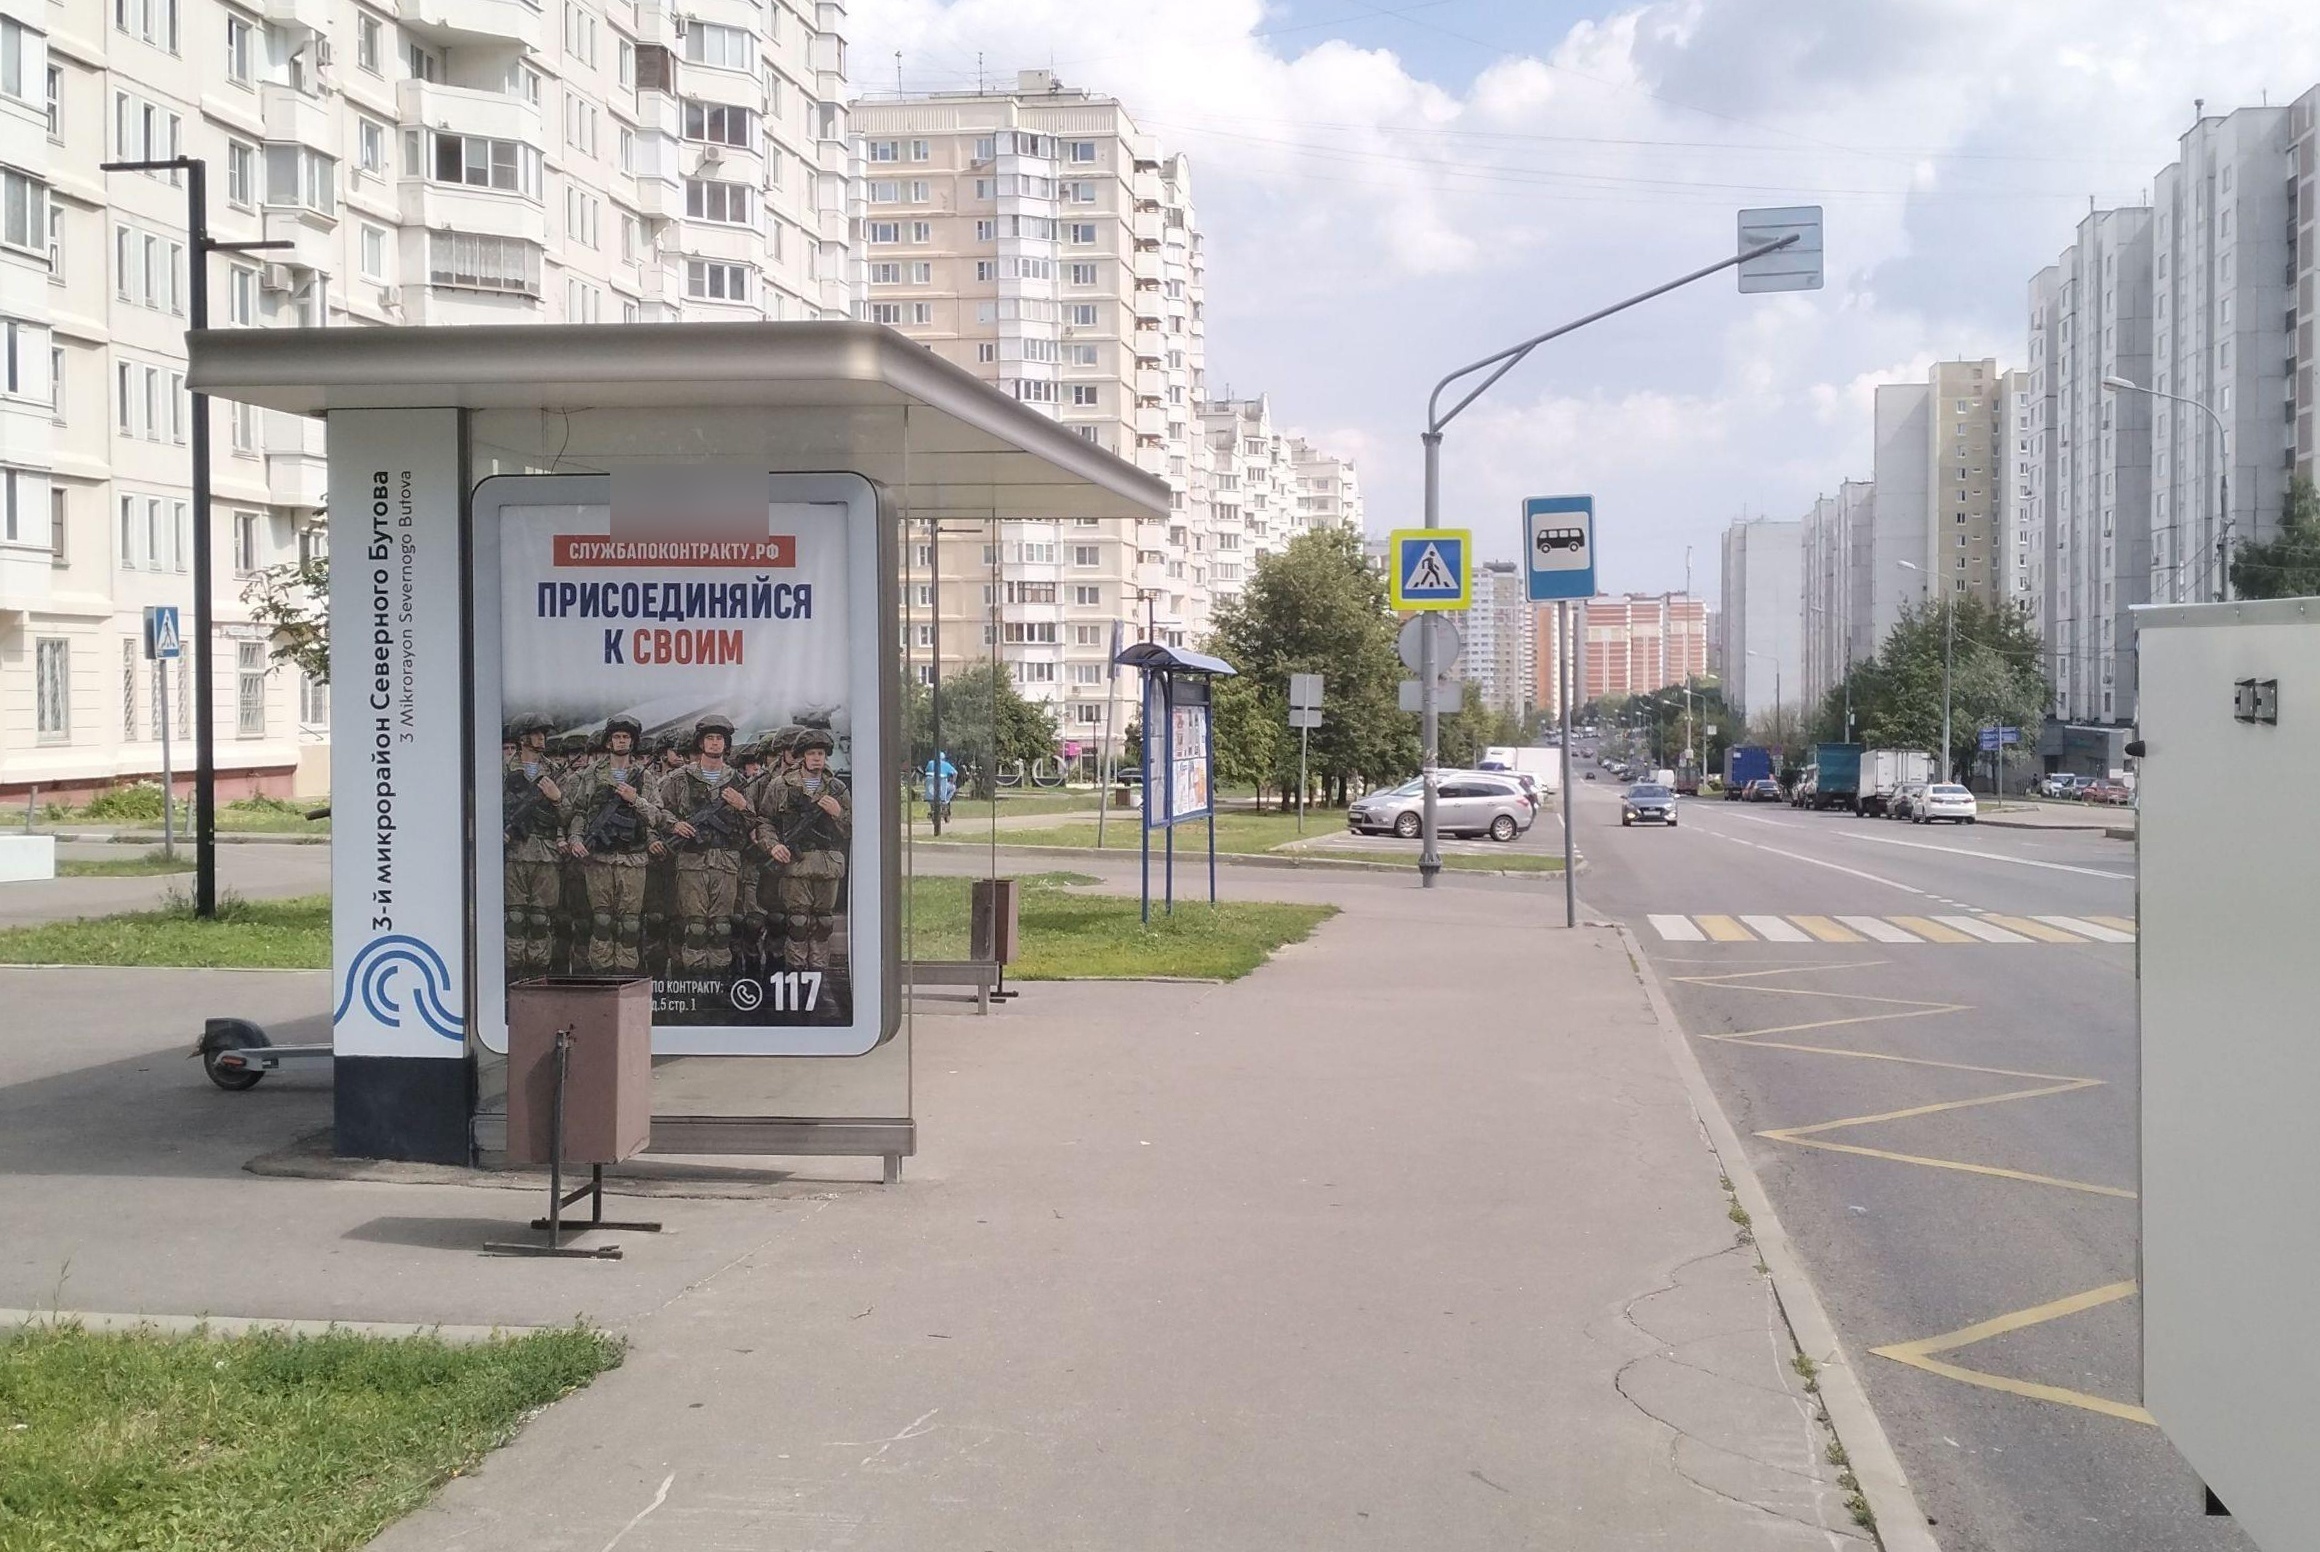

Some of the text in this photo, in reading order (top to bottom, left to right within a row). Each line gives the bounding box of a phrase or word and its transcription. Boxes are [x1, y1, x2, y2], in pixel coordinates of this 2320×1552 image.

[569, 542, 780, 560] СЛУЖБАПОКОНТРАКТУ.РФ
[398, 470, 416, 743] 3 Mikrorayon Severnogo Butova
[537, 575, 812, 622] ПРИСОЕДИНЯЙСЯ
[604, 628, 744, 665] К СВОИМ
[368, 471, 397, 931] 3-й микрорайон Северного Бутова
[667, 980, 724, 994] КОНТРАКТУ:
[668, 1000, 689, 1013] стр.
[691, 998, 697, 1011] 1
[770, 971, 822, 1012] 117
